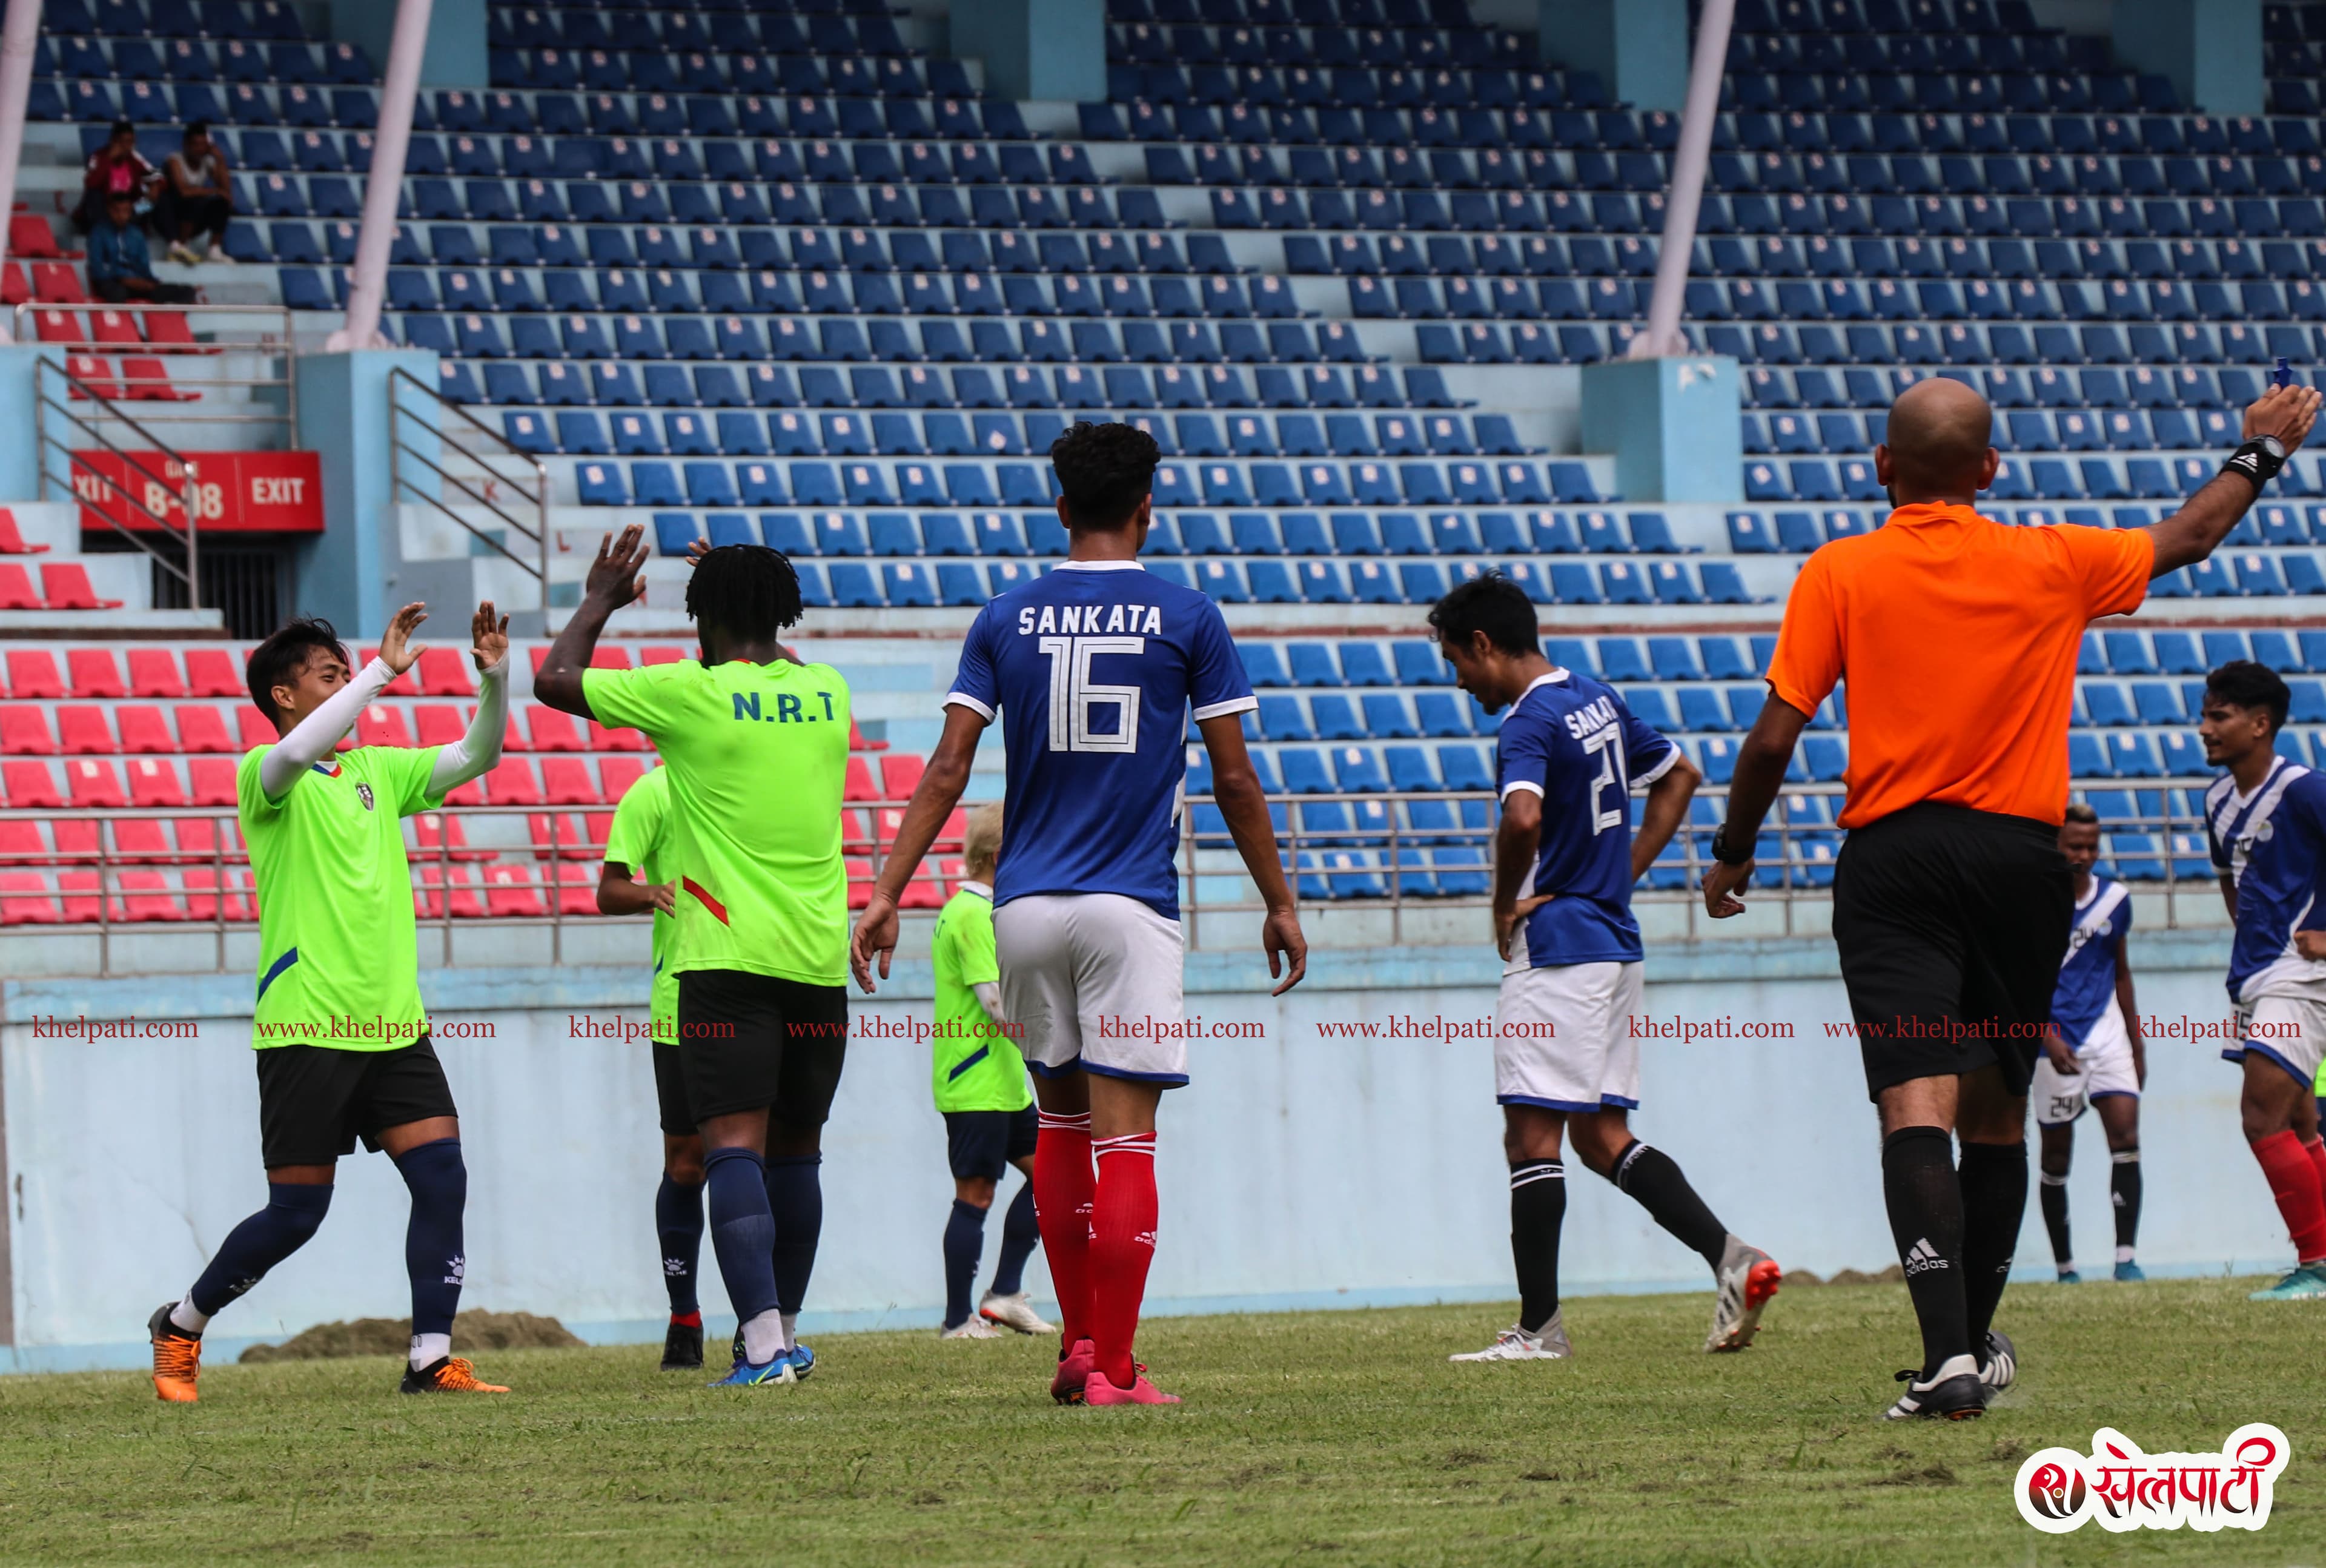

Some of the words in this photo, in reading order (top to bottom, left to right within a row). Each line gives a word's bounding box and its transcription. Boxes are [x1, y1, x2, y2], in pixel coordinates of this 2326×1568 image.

[251, 476, 305, 504] EXIT
[1018, 604, 1162, 635] SANKATA
[732, 691, 835, 723] N.R.T
[1038, 637, 1145, 753] 16
[2050, 1096, 2073, 1118] 24
